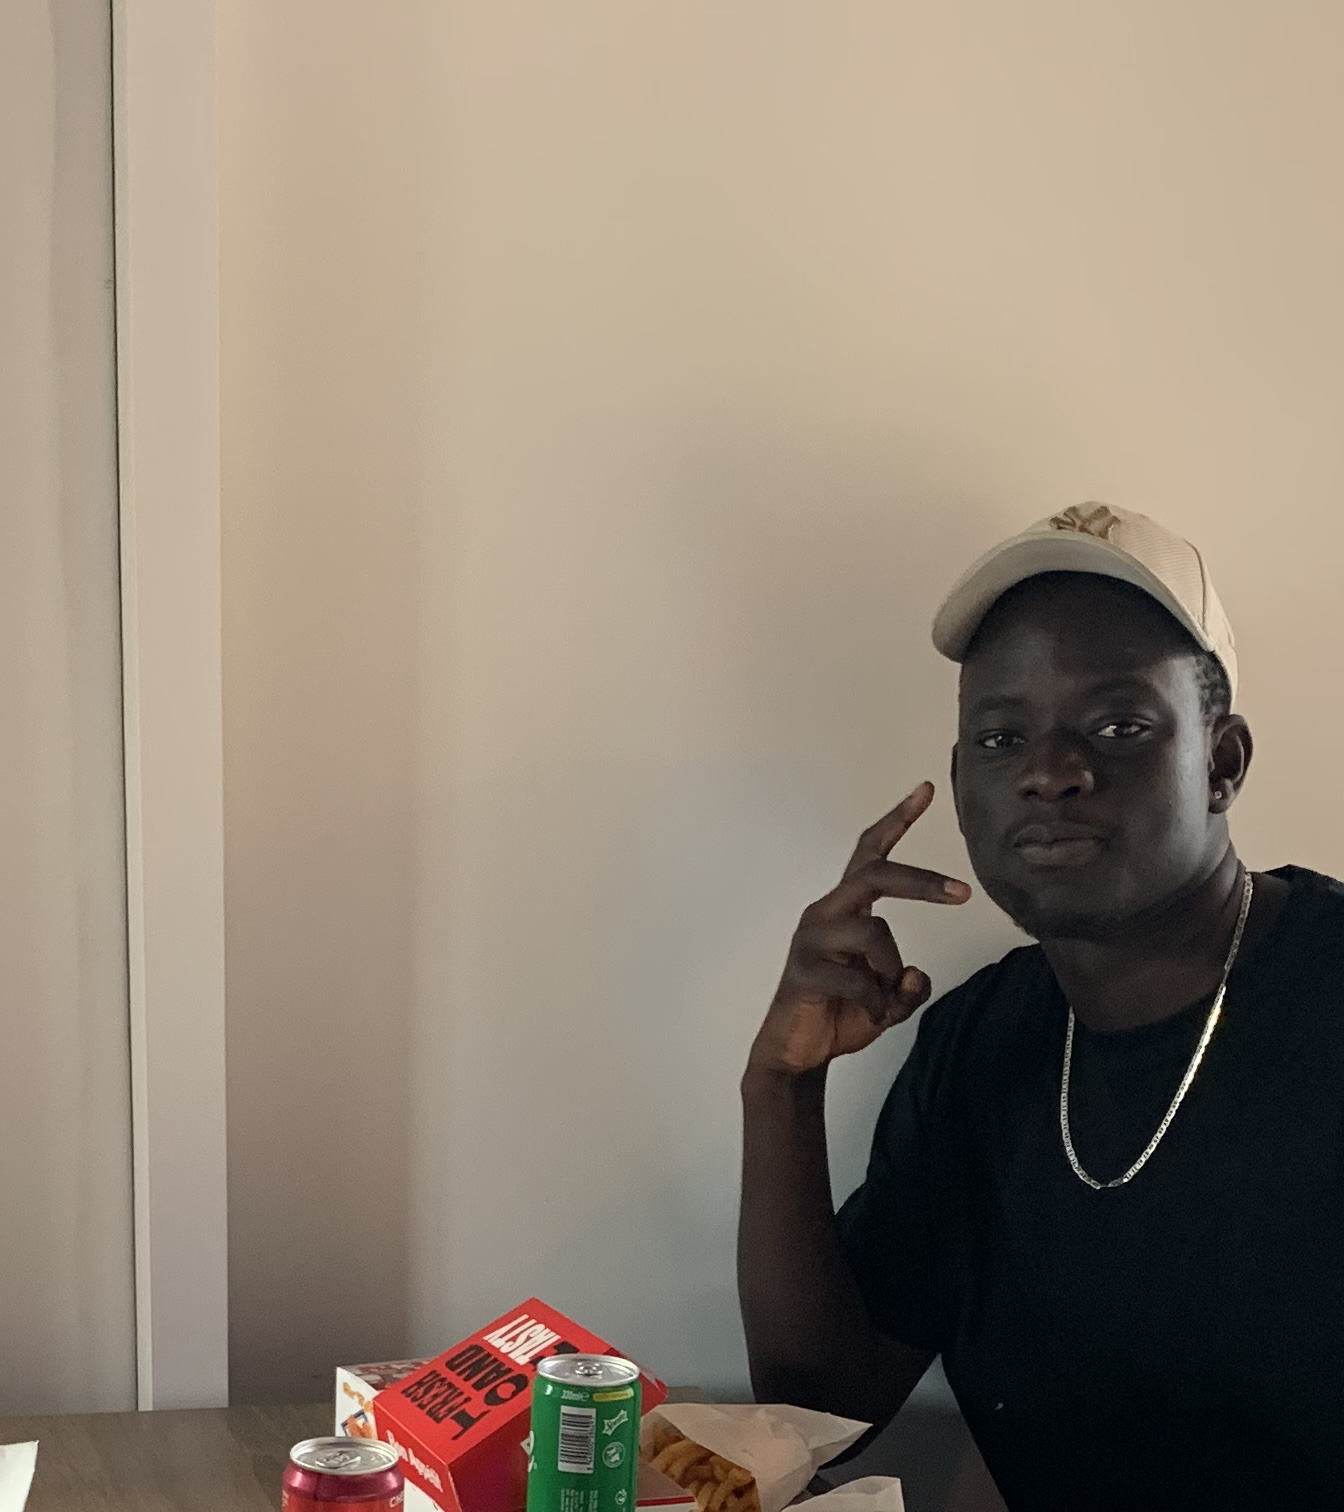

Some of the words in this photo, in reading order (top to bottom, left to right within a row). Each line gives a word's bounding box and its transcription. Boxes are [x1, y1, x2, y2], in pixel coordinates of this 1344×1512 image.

[483, 1313, 561, 1366] TASTY
[445, 1344, 514, 1392] AND
[400, 1369, 473, 1425] FRESH
